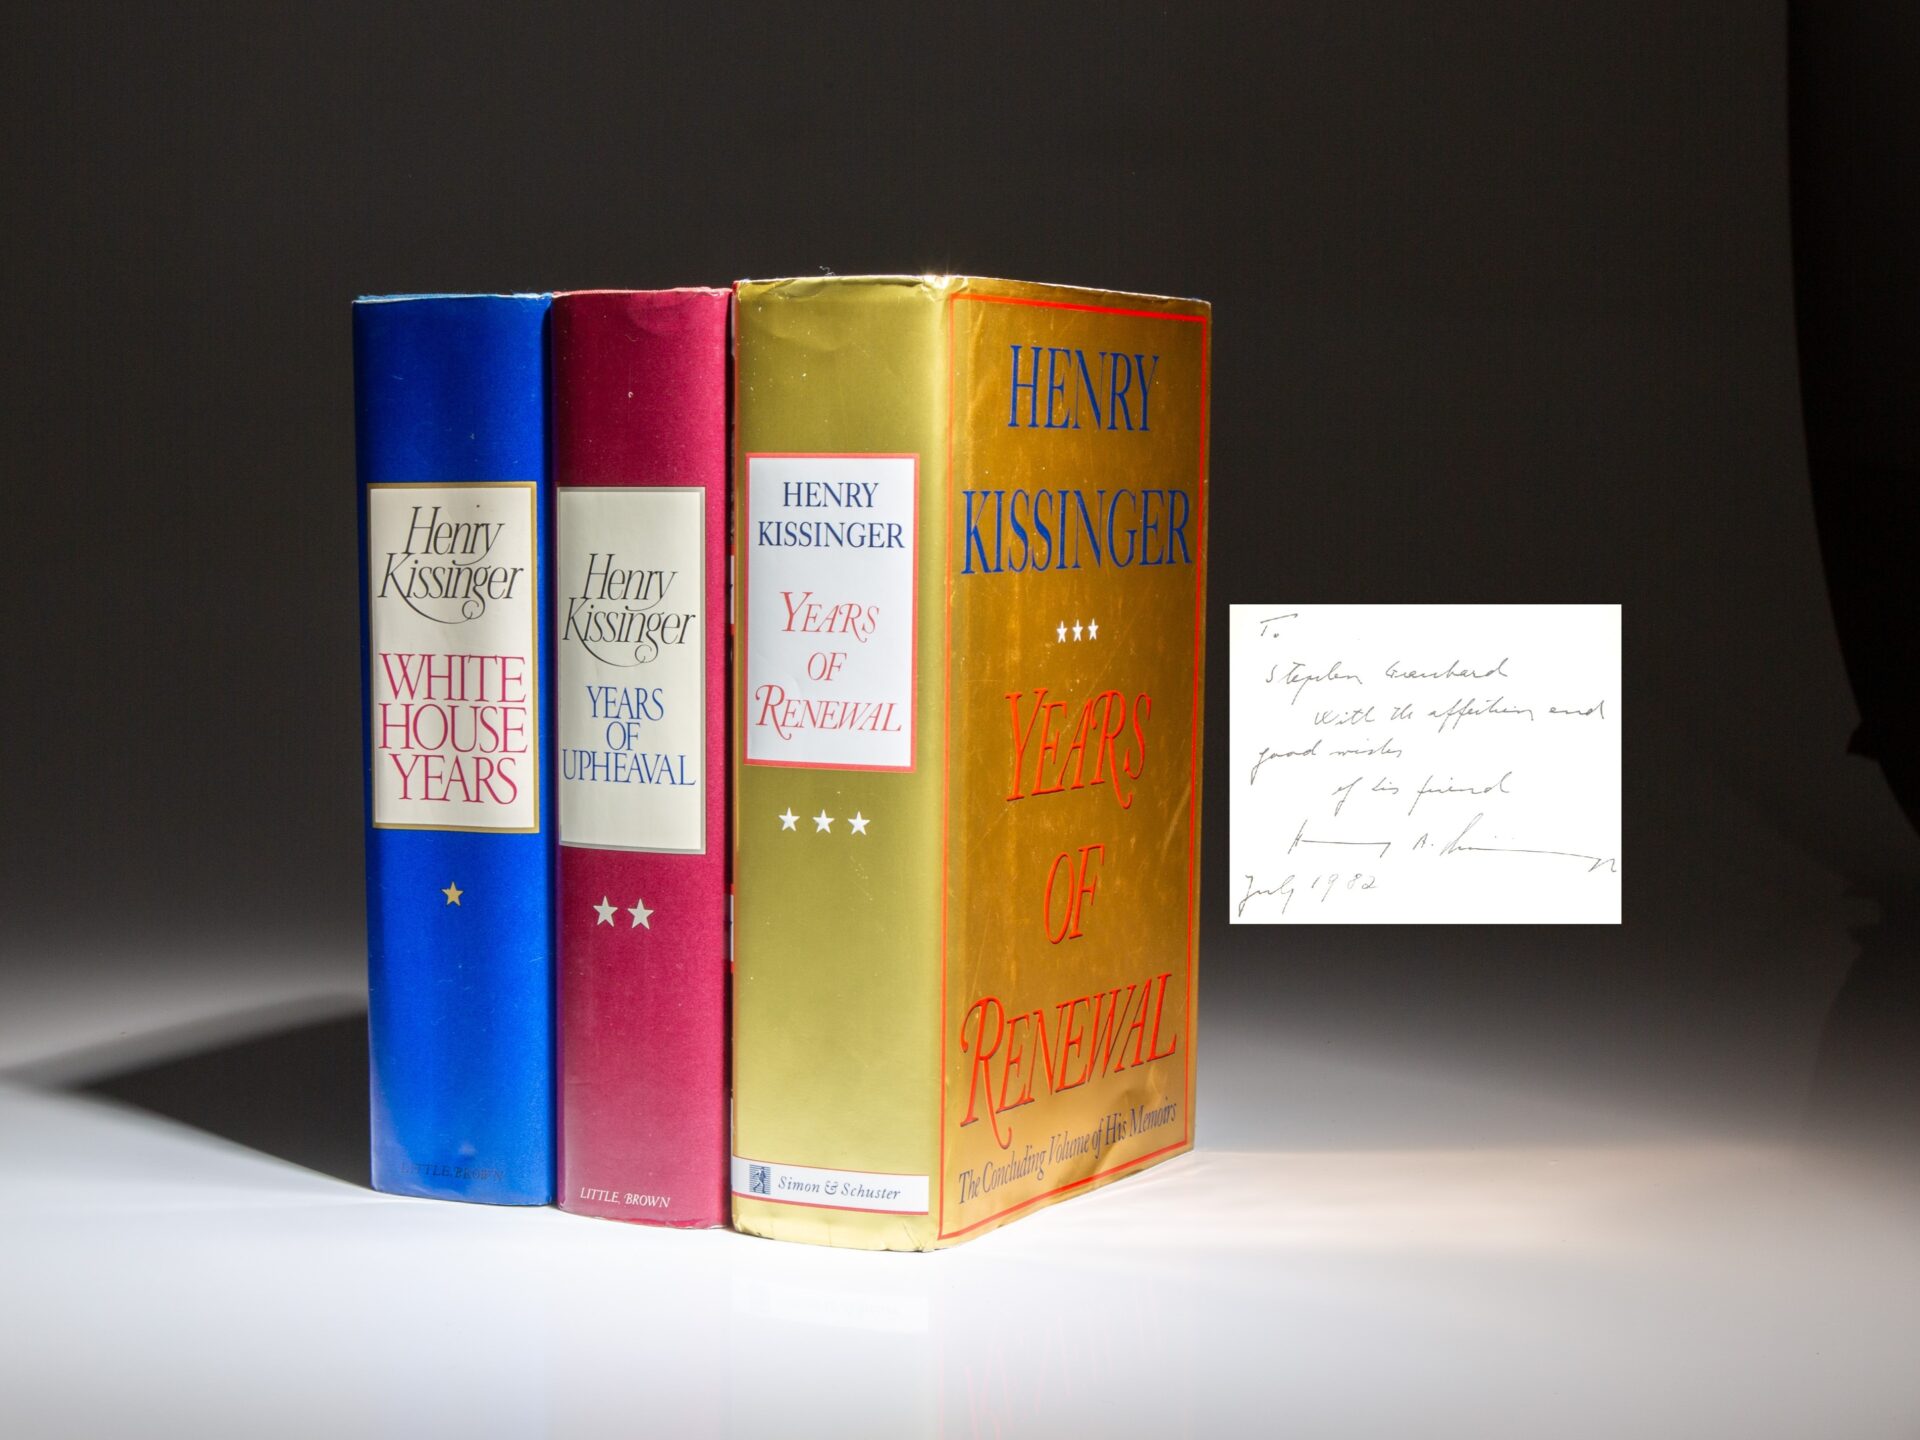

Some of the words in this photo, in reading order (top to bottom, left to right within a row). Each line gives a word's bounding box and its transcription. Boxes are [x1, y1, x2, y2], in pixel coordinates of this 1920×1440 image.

[1008, 345, 1159, 431] HENRY
[783, 482, 879, 508] HENRY
[402, 506, 505, 566] Henry
[758, 521, 905, 549] KISSINGER
[961, 489, 1192, 574] KISSINGER
[377, 553, 524, 625] Kissinger
[581, 553, 678, 612] Henry
[562, 597, 696, 668] Kissinger
[779, 592, 880, 643] YEARS
[379, 653, 527, 703] WHITE
[807, 652, 847, 682] OF
[378, 703, 528, 754] HOUSE
[586, 686, 664, 721] YEARS
[755, 684, 903, 741] RENEWAL
[606, 721, 640, 751] OF
[1004, 688, 1152, 809] YEARS
[1250, 739, 1323, 786] good
[1329, 737, 1402, 758] wishes
[389, 754, 518, 805] YEARS
[562, 749, 697, 786] UPHEAVAL
[1331, 776, 1364, 817] of
[1408, 771, 1512, 816] friend
[1043, 844, 1104, 944] OF
[1238, 874, 1296, 920] July
[1311, 872, 1377, 903] 1982
[960, 972, 1177, 1150] RENEWAL
[959, 1169, 981, 1205] The
[982, 1145, 1047, 1181] Concluding
[1047, 1130, 1091, 1167] Volume
[1091, 1118, 1105, 1160] of
[1105, 1112, 1128, 1147] His
[1129, 1097, 1178, 1138] Memoirs
[624, 1192, 671, 1209] BROWN
[778, 1175, 820, 1194] Simon
[824, 1180, 839, 1196] &
[840, 1183, 901, 1201] Schuster
